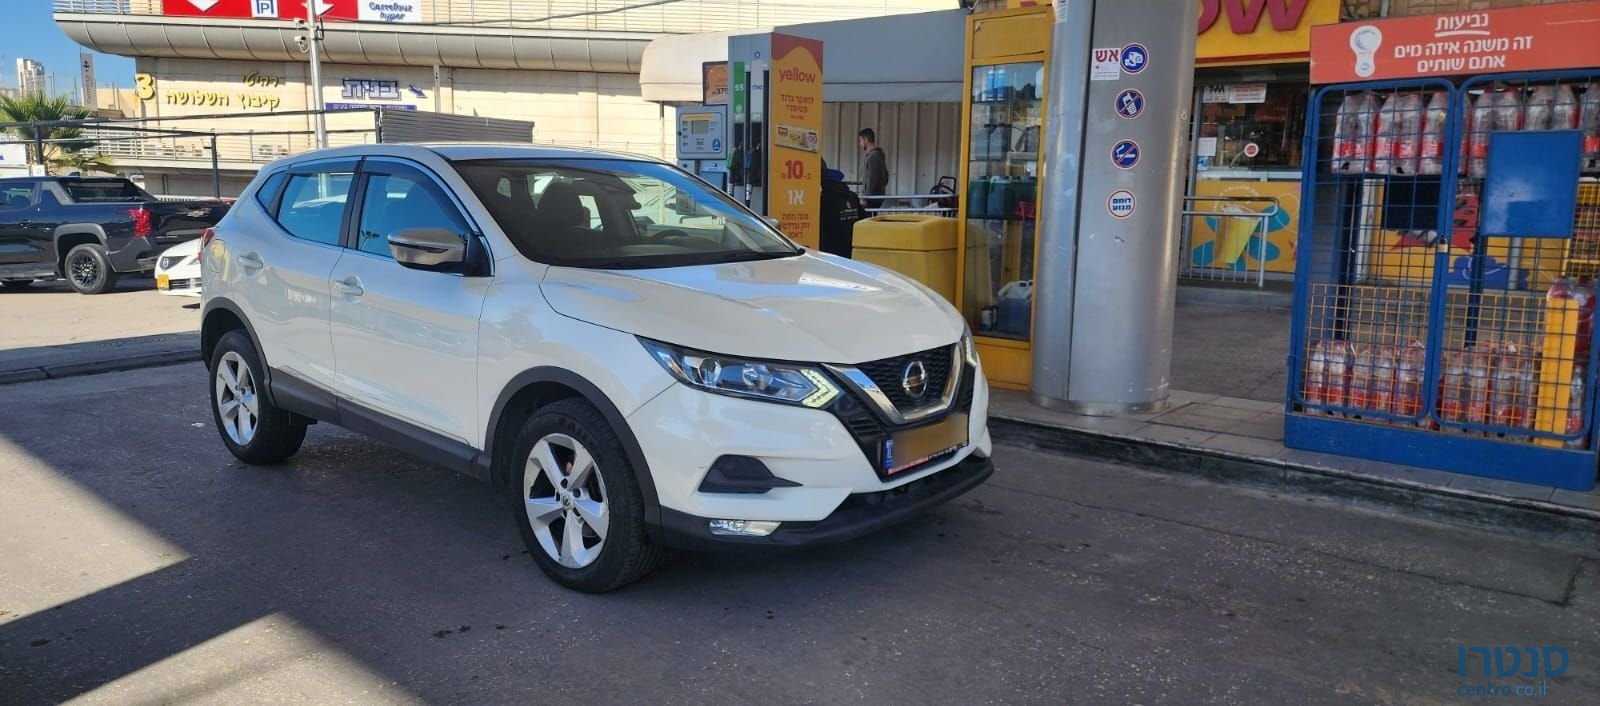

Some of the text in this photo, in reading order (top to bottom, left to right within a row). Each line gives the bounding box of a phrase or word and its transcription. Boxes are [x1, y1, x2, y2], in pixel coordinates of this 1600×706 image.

[369, 2, 413, 12] Carrefour
[1435, 13, 1489, 30] נביעות
[1394, 35, 1533, 58] זה משנה איזה מים
[1095, 50, 1119, 62] אש
[1417, 55, 1505, 72] אתם שותים
[779, 67, 817, 83] yellow
[135, 72, 155, 100] 3
[167, 90, 280, 112] קיבוץ השלושה
[788, 189, 805, 206] או
